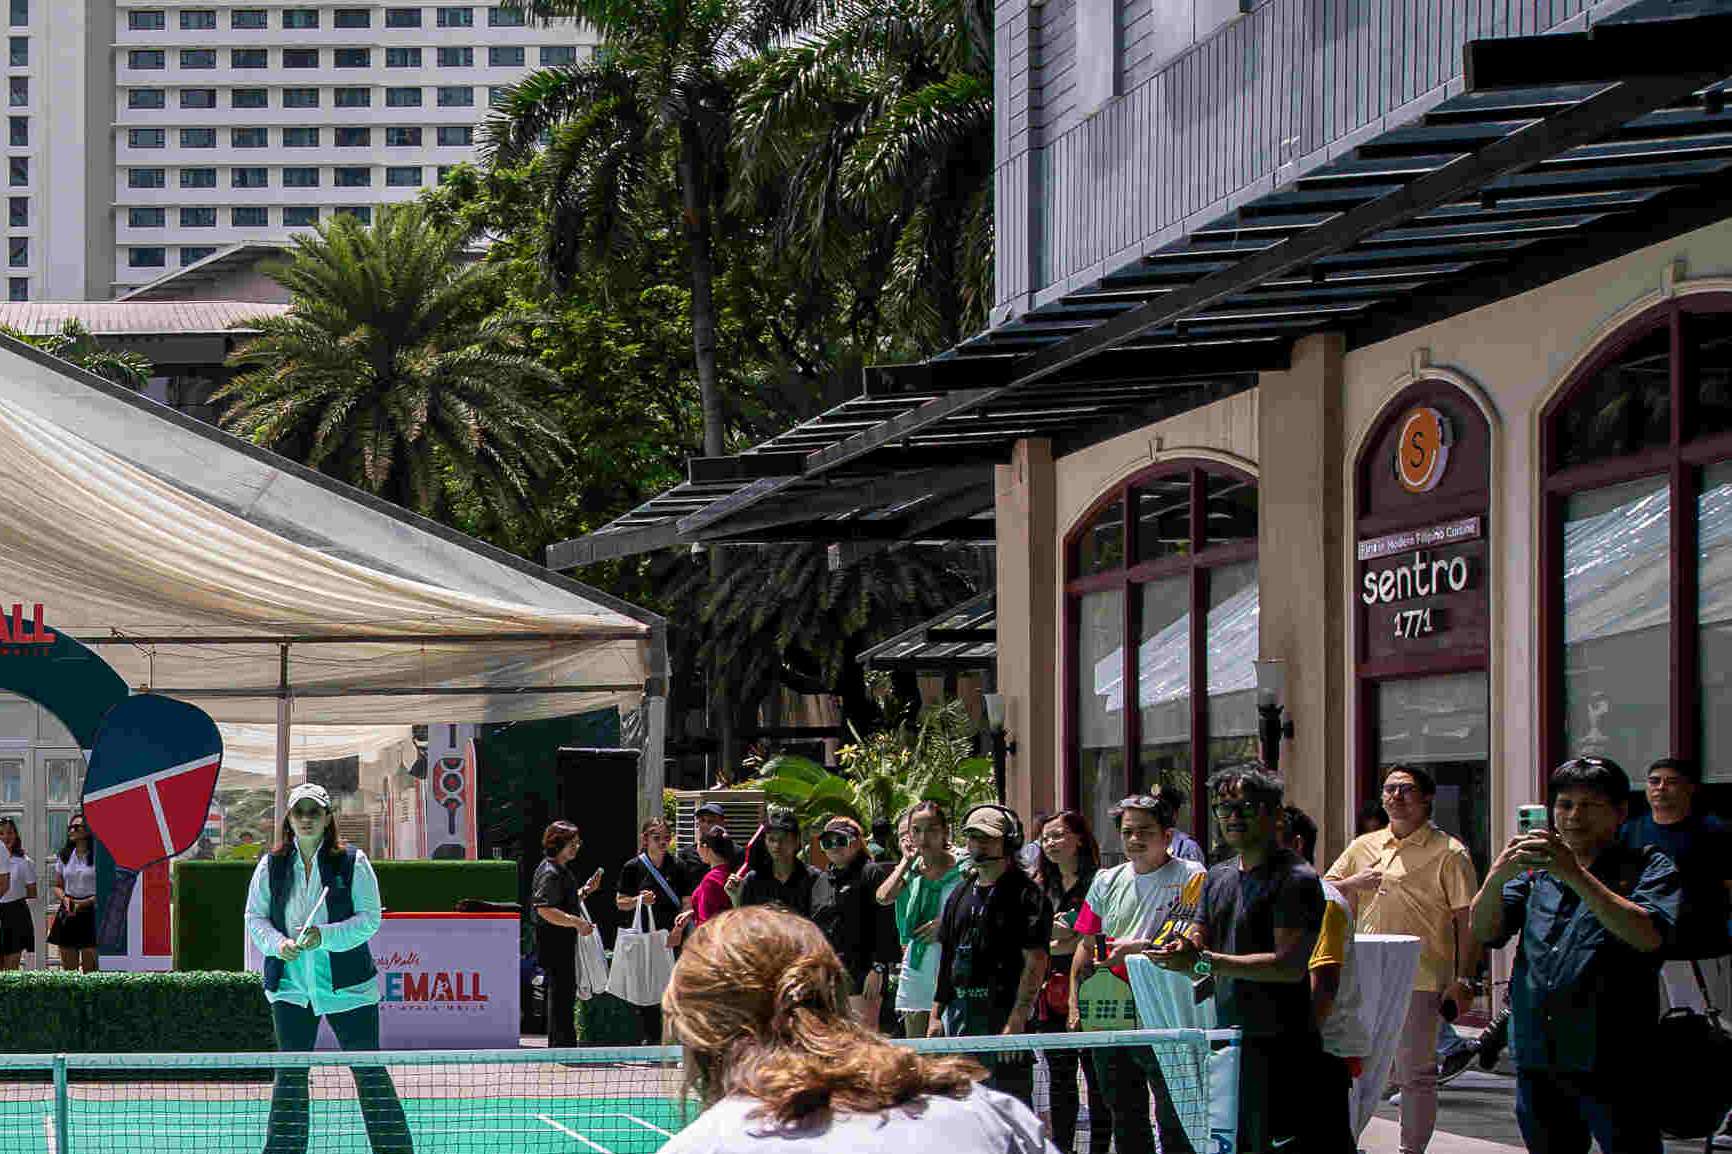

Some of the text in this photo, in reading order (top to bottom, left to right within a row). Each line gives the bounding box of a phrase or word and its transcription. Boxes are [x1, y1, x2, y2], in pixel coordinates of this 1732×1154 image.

[1362, 551, 1467, 605] sentro
[1394, 607, 1433, 640] 1771
[382, 971, 489, 1002] EMALL
